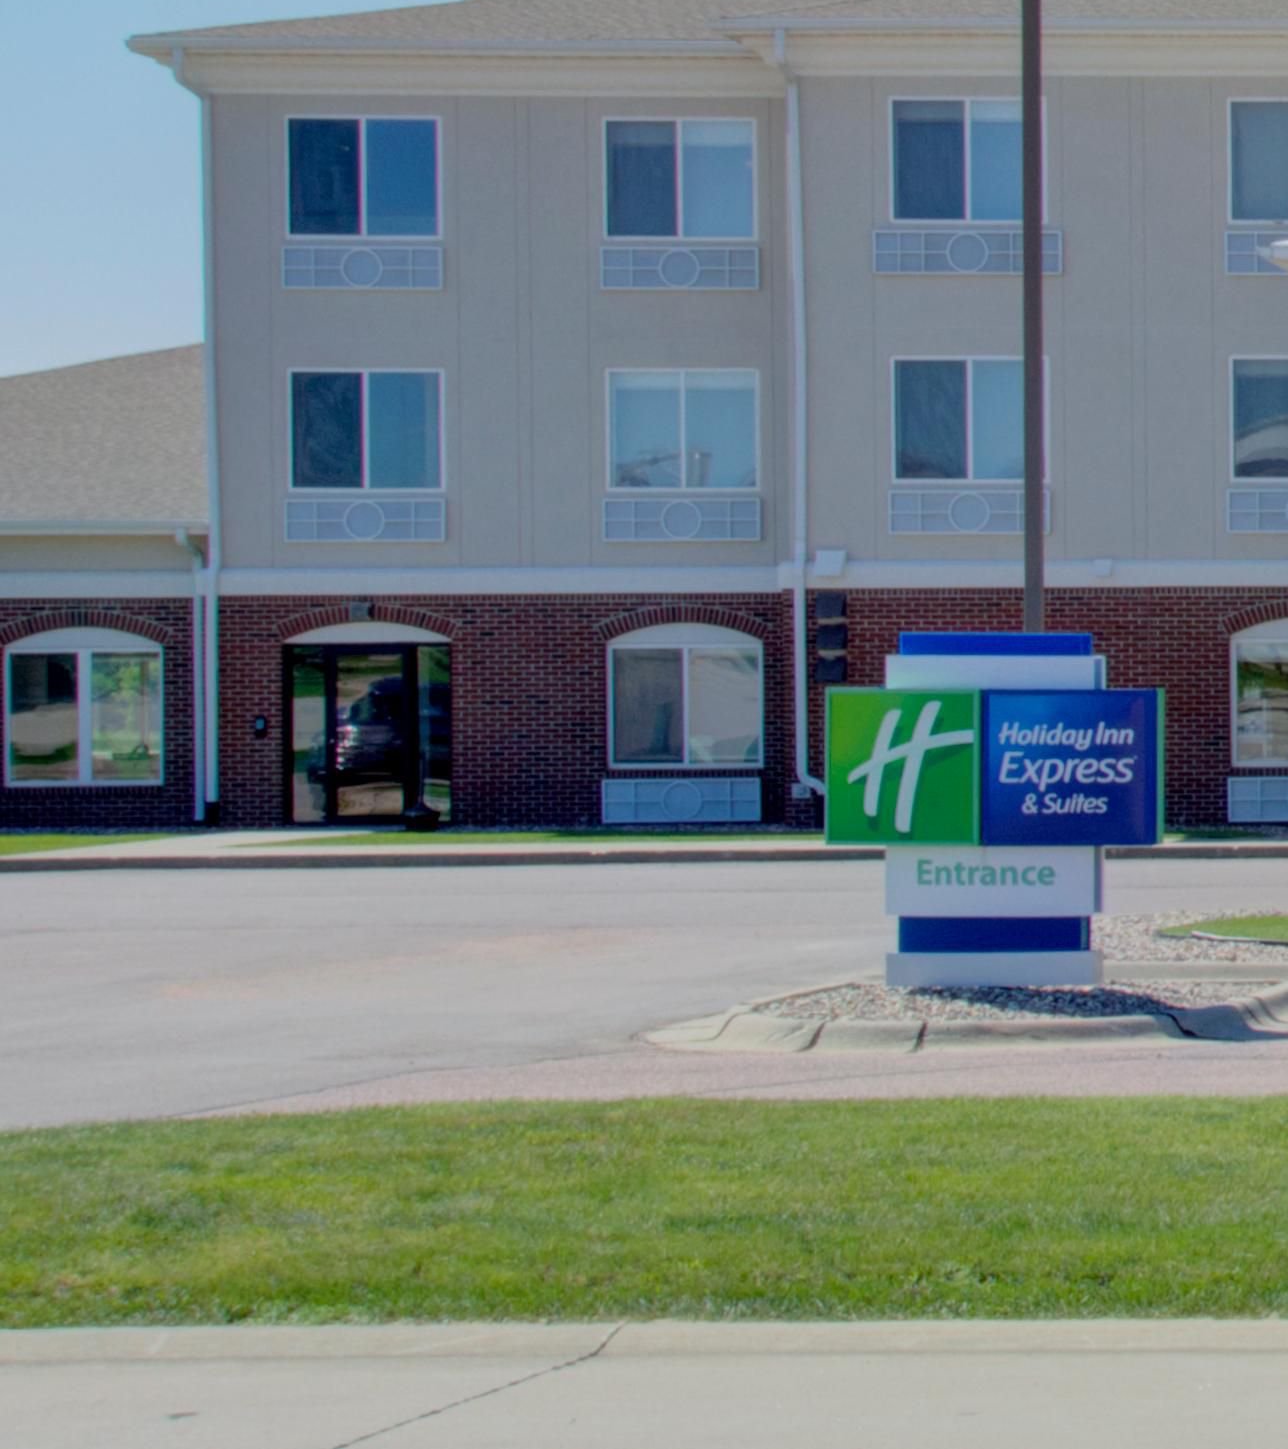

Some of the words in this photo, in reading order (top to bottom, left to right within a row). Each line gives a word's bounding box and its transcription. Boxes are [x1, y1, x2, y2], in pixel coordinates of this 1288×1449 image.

[998, 721, 1093, 751] Holiday
[1095, 720, 1135, 746] Inn
[847, 699, 975, 834] H
[998, 750, 1136, 792] Express
[1021, 792, 1039, 814] &
[1041, 792, 1109, 814] Suites
[916, 859, 1057, 887] Entrance
